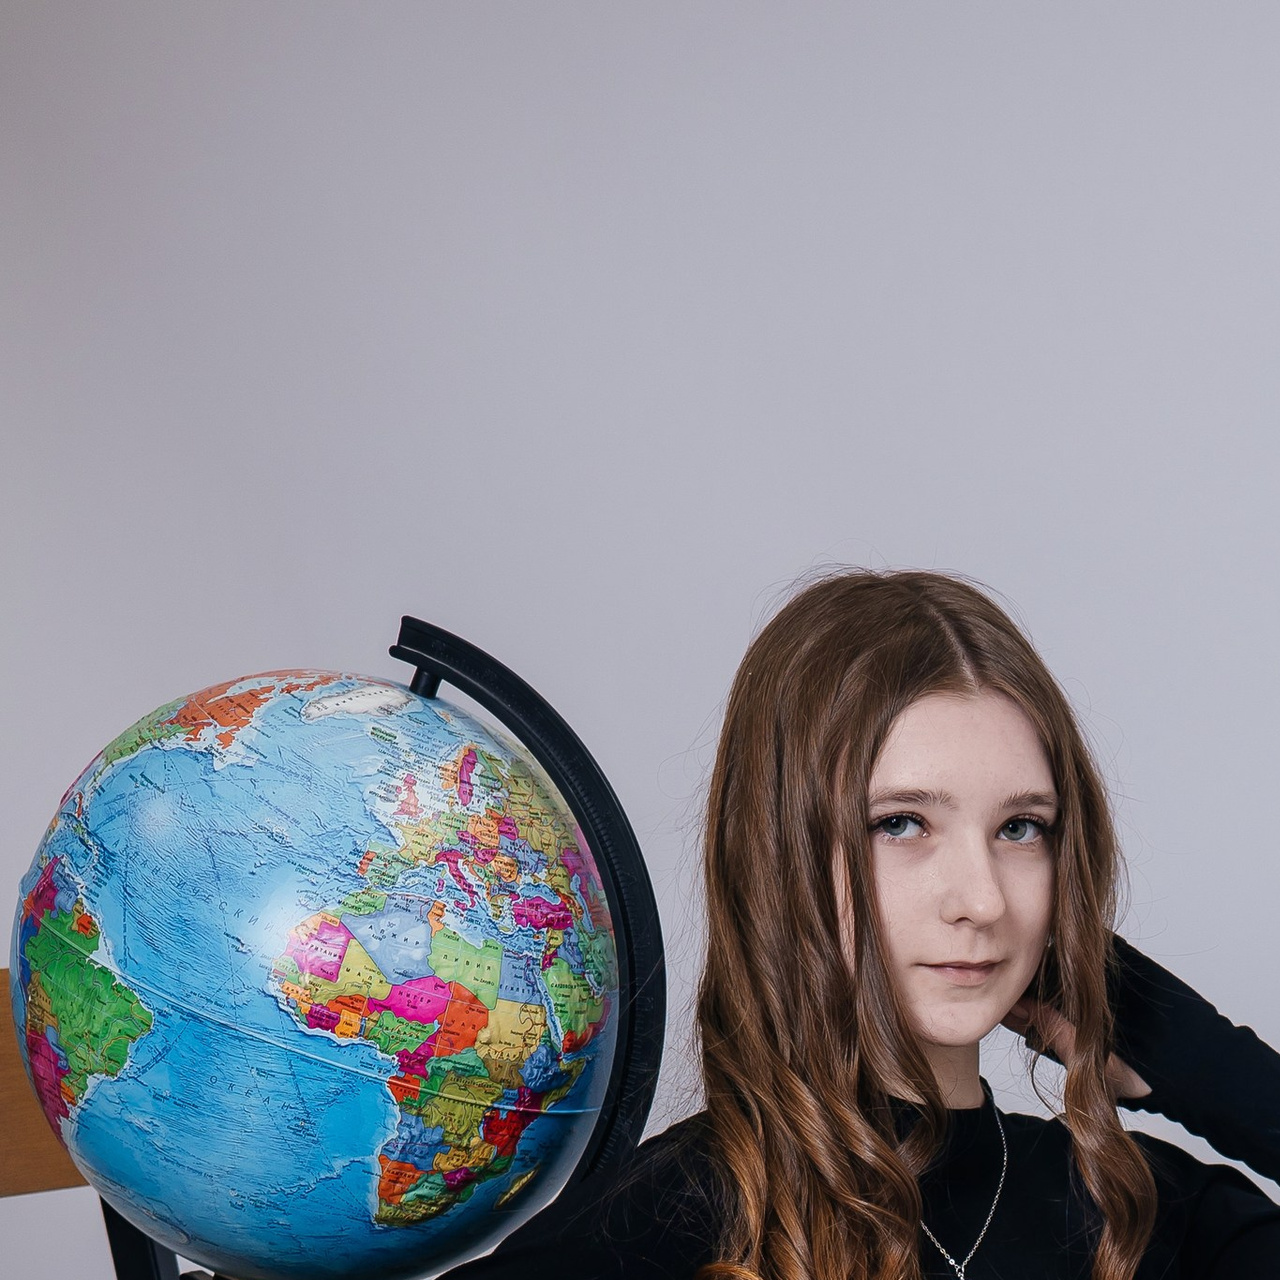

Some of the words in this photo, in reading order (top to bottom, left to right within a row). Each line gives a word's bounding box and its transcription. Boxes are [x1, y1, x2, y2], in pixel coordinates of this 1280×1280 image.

[368, 924, 420, 946] АЛЖИР
[442, 953, 491, 972] ЛИВИЯ
[345, 966, 384, 985] МАЛИ
[398, 990, 432, 1005] НИГЕР
[209, 1074, 291, 1111] ОКЕАН
